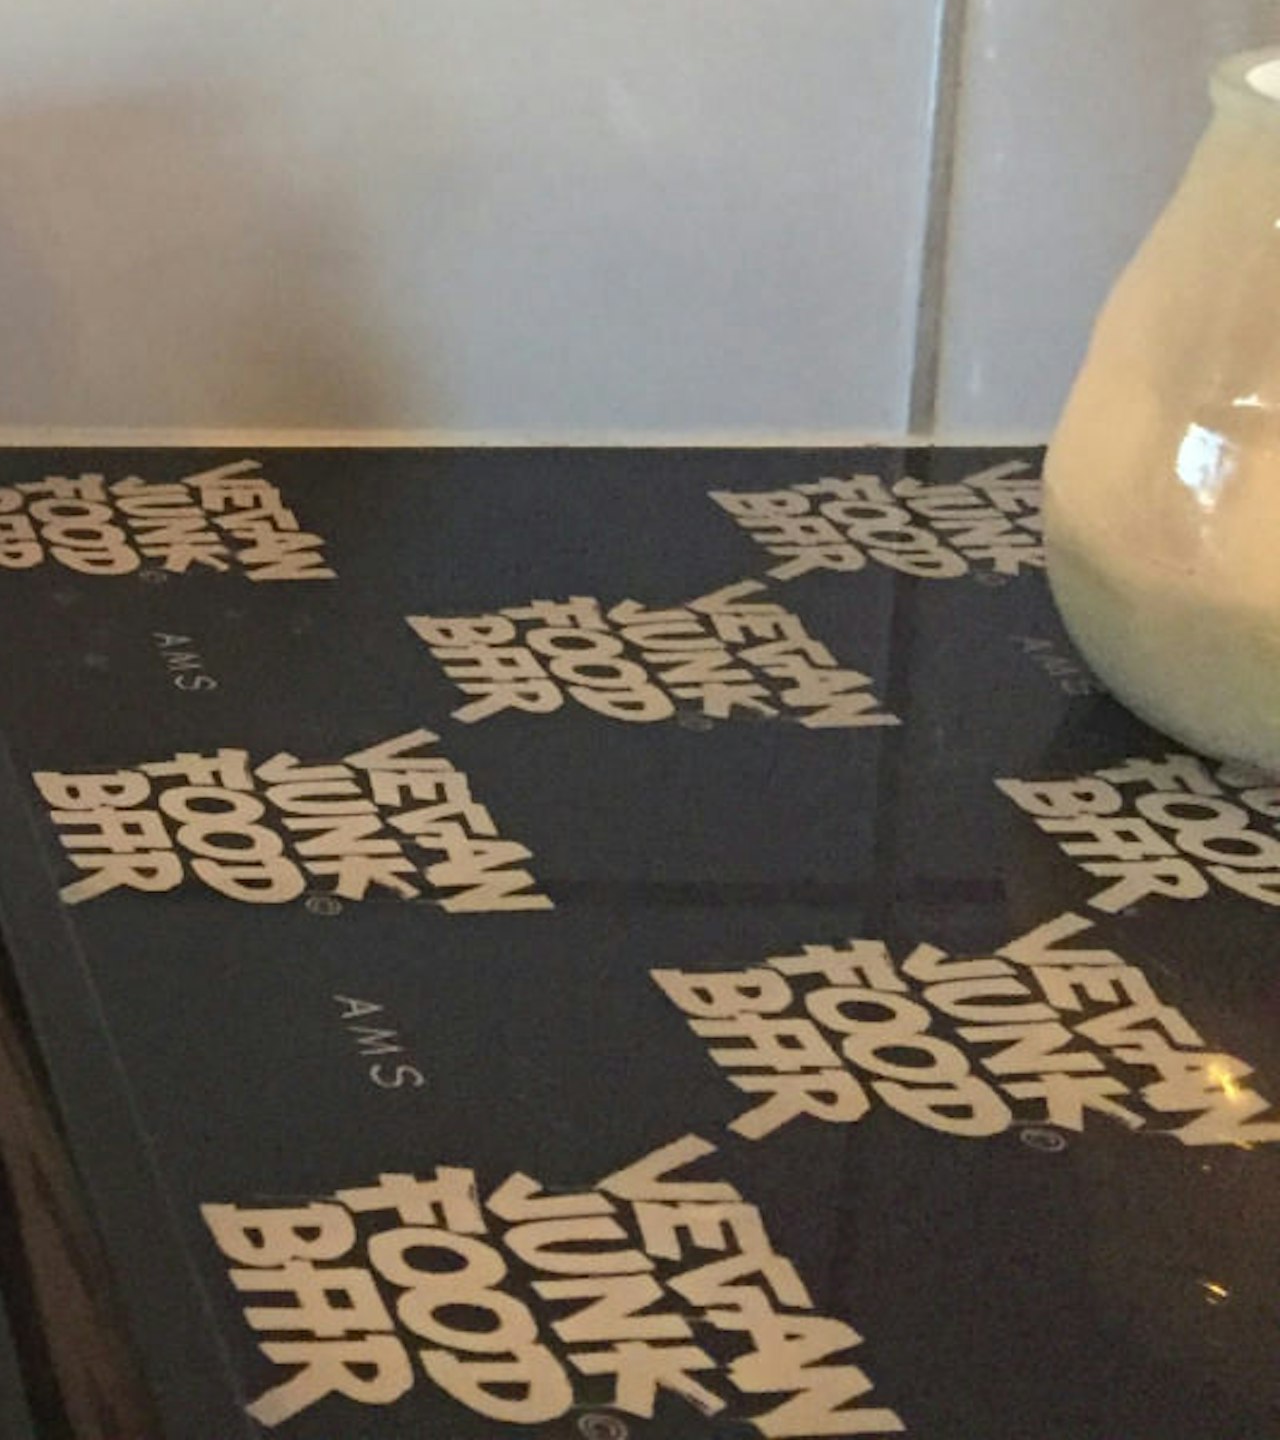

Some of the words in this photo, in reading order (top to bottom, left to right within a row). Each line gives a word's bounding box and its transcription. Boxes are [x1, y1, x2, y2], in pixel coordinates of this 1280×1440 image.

[15, 474, 141, 576] FOOD
[110, 477, 230, 574] JUNK
[182, 460, 338, 581] VEGAN
[153, 632, 216, 691] AMS
[31, 769, 184, 905] BAR
[140, 748, 307, 904] FOOD
[255, 752, 421, 901] JUNK
[343, 729, 555, 912] VEGAN
[994, 777, 1209, 914] BAR
[334, 994, 424, 1093] AMS
[650, 967, 871, 1140] BAR
[766, 939, 1013, 1137] FOOD
[901, 942, 1146, 1132] JUNK
[996, 911, 1280, 1146] VEGAN
[199, 1201, 415, 1427] BAR
[335, 1165, 574, 1424] FOOD
[487, 1172, 728, 1417] JUNK
[596, 1133, 906, 1438] VEGAN
